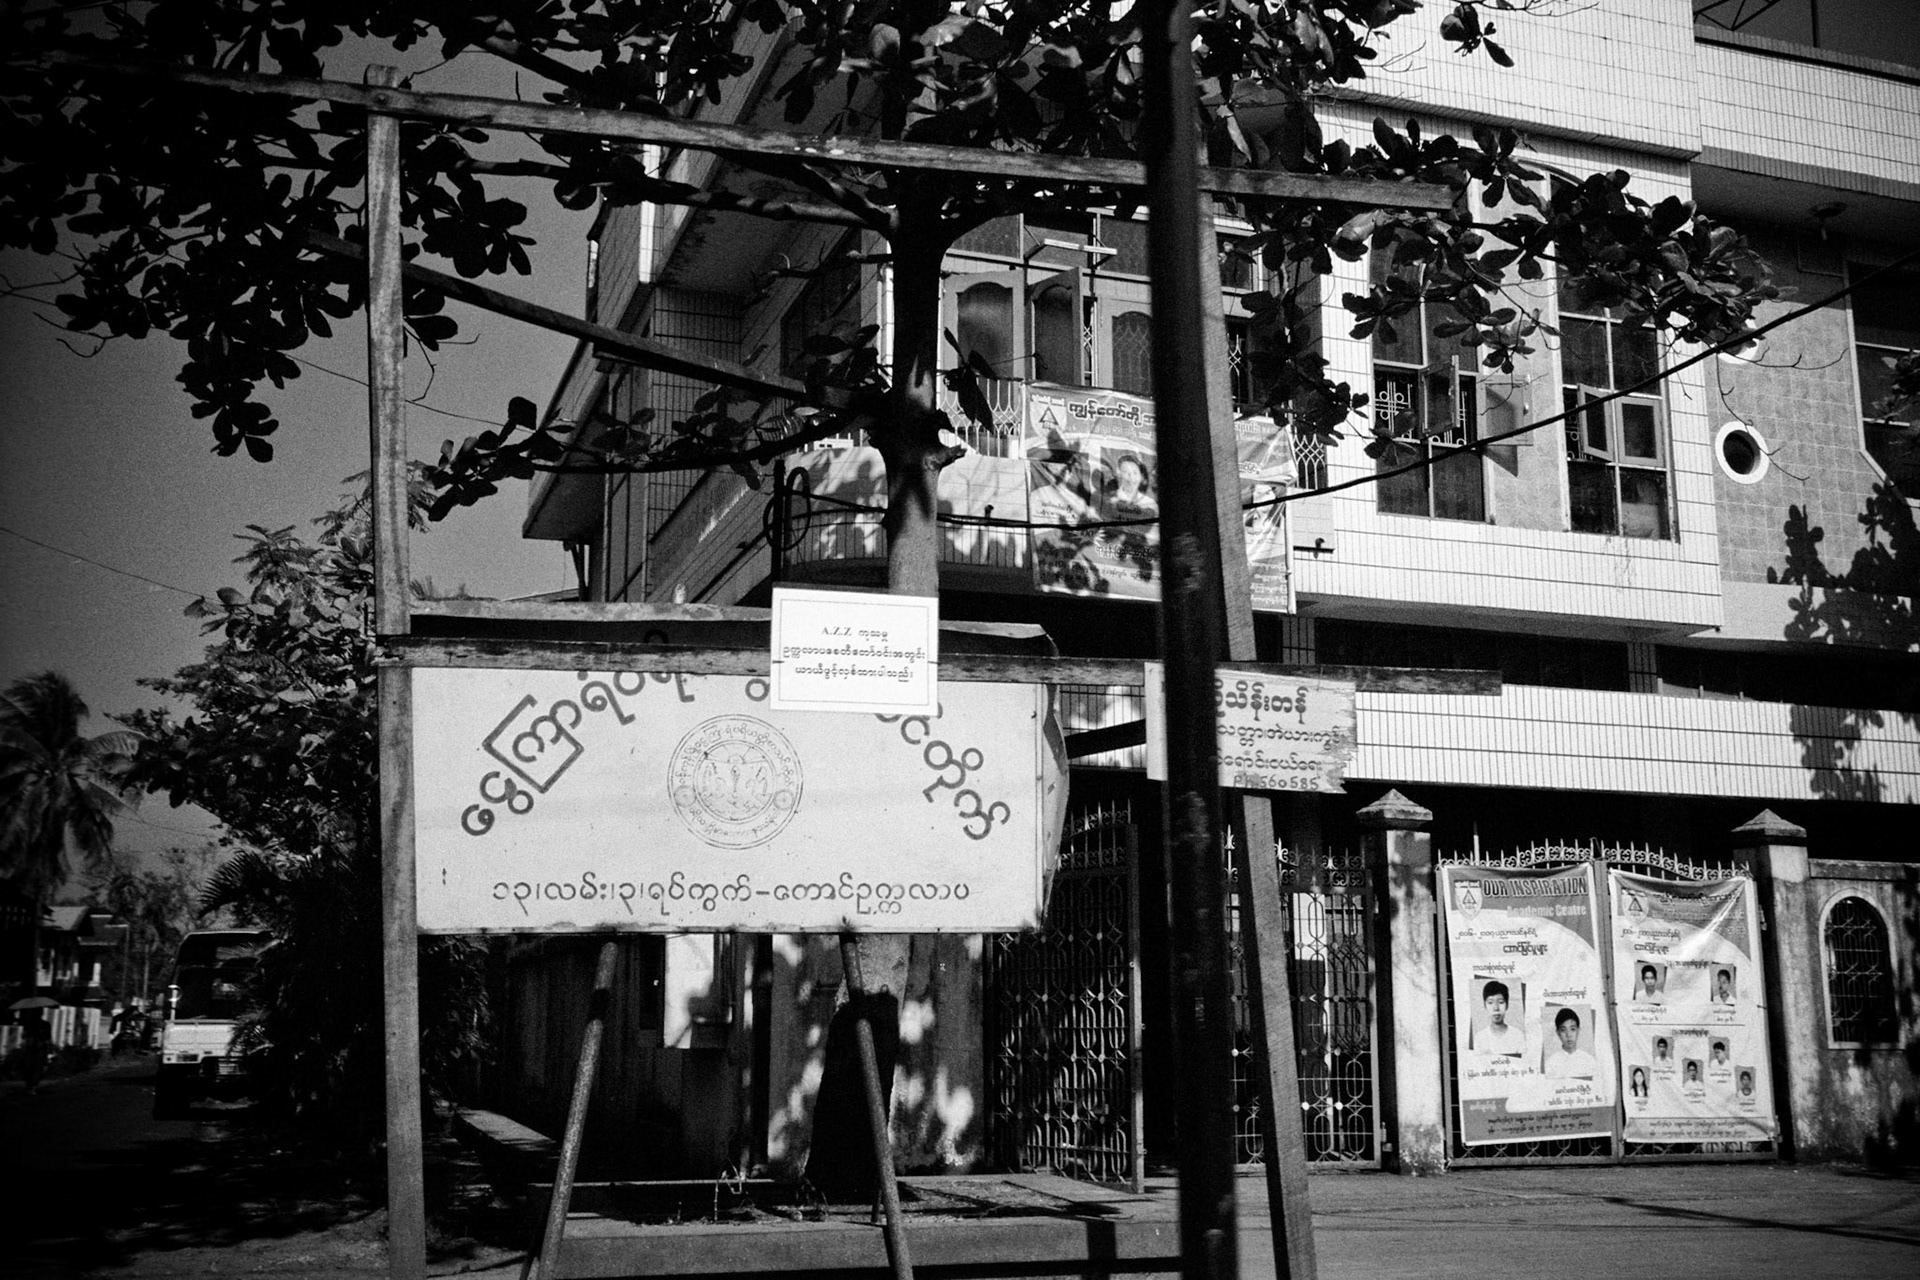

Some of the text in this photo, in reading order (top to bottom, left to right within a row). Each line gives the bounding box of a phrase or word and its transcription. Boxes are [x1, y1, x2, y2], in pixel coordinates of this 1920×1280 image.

[1483, 878, 1508, 897] OUR
[1511, 877, 1588, 897] INSPIRATION
[1556, 904, 1587, 917] Centre
